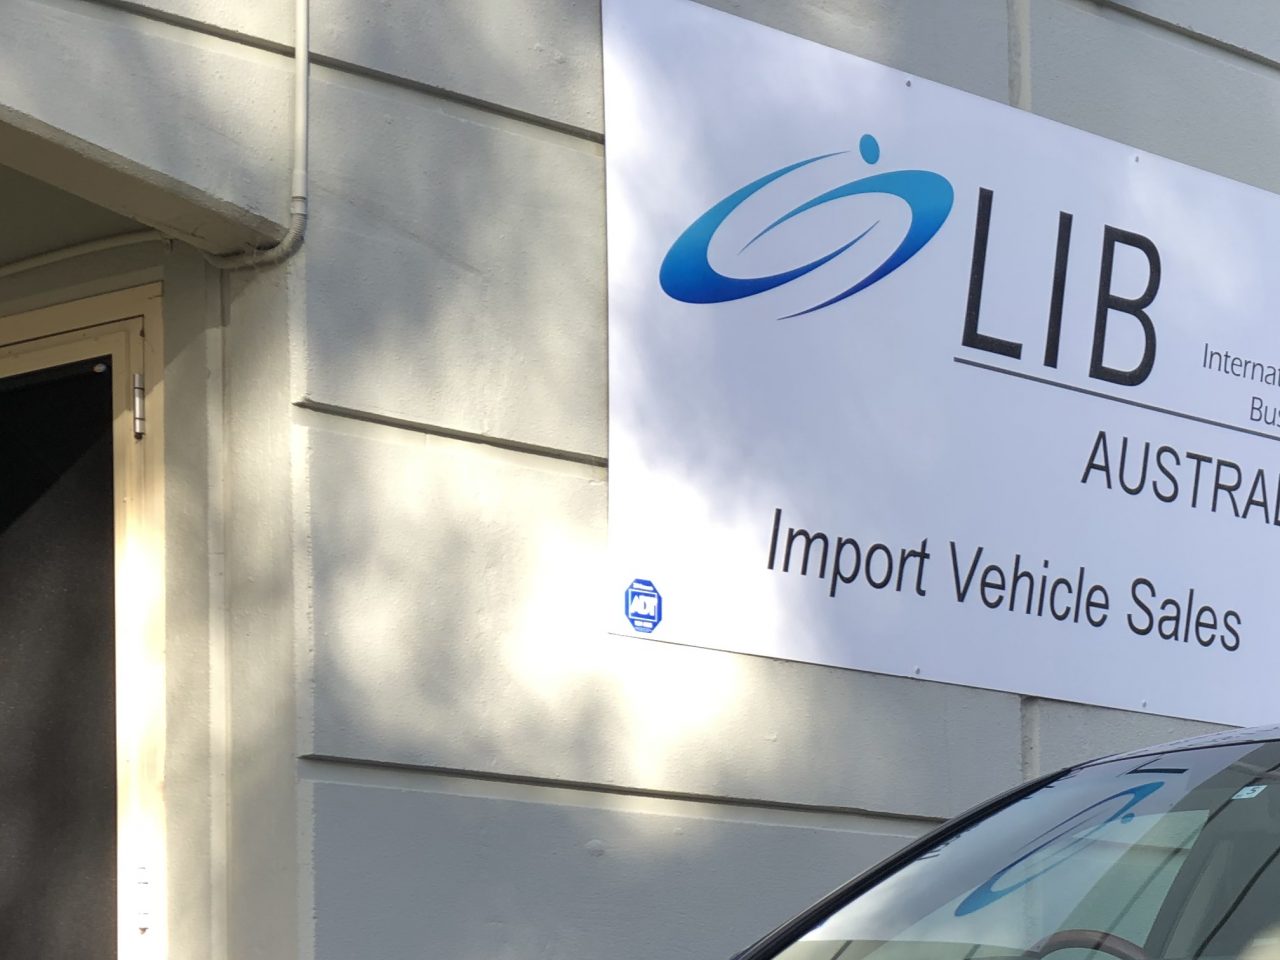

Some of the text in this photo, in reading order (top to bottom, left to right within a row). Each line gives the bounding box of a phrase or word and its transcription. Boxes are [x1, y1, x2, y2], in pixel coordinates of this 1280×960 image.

[961, 186, 1163, 387] LIB
[767, 508, 1242, 652] Import Vehicle Sales
